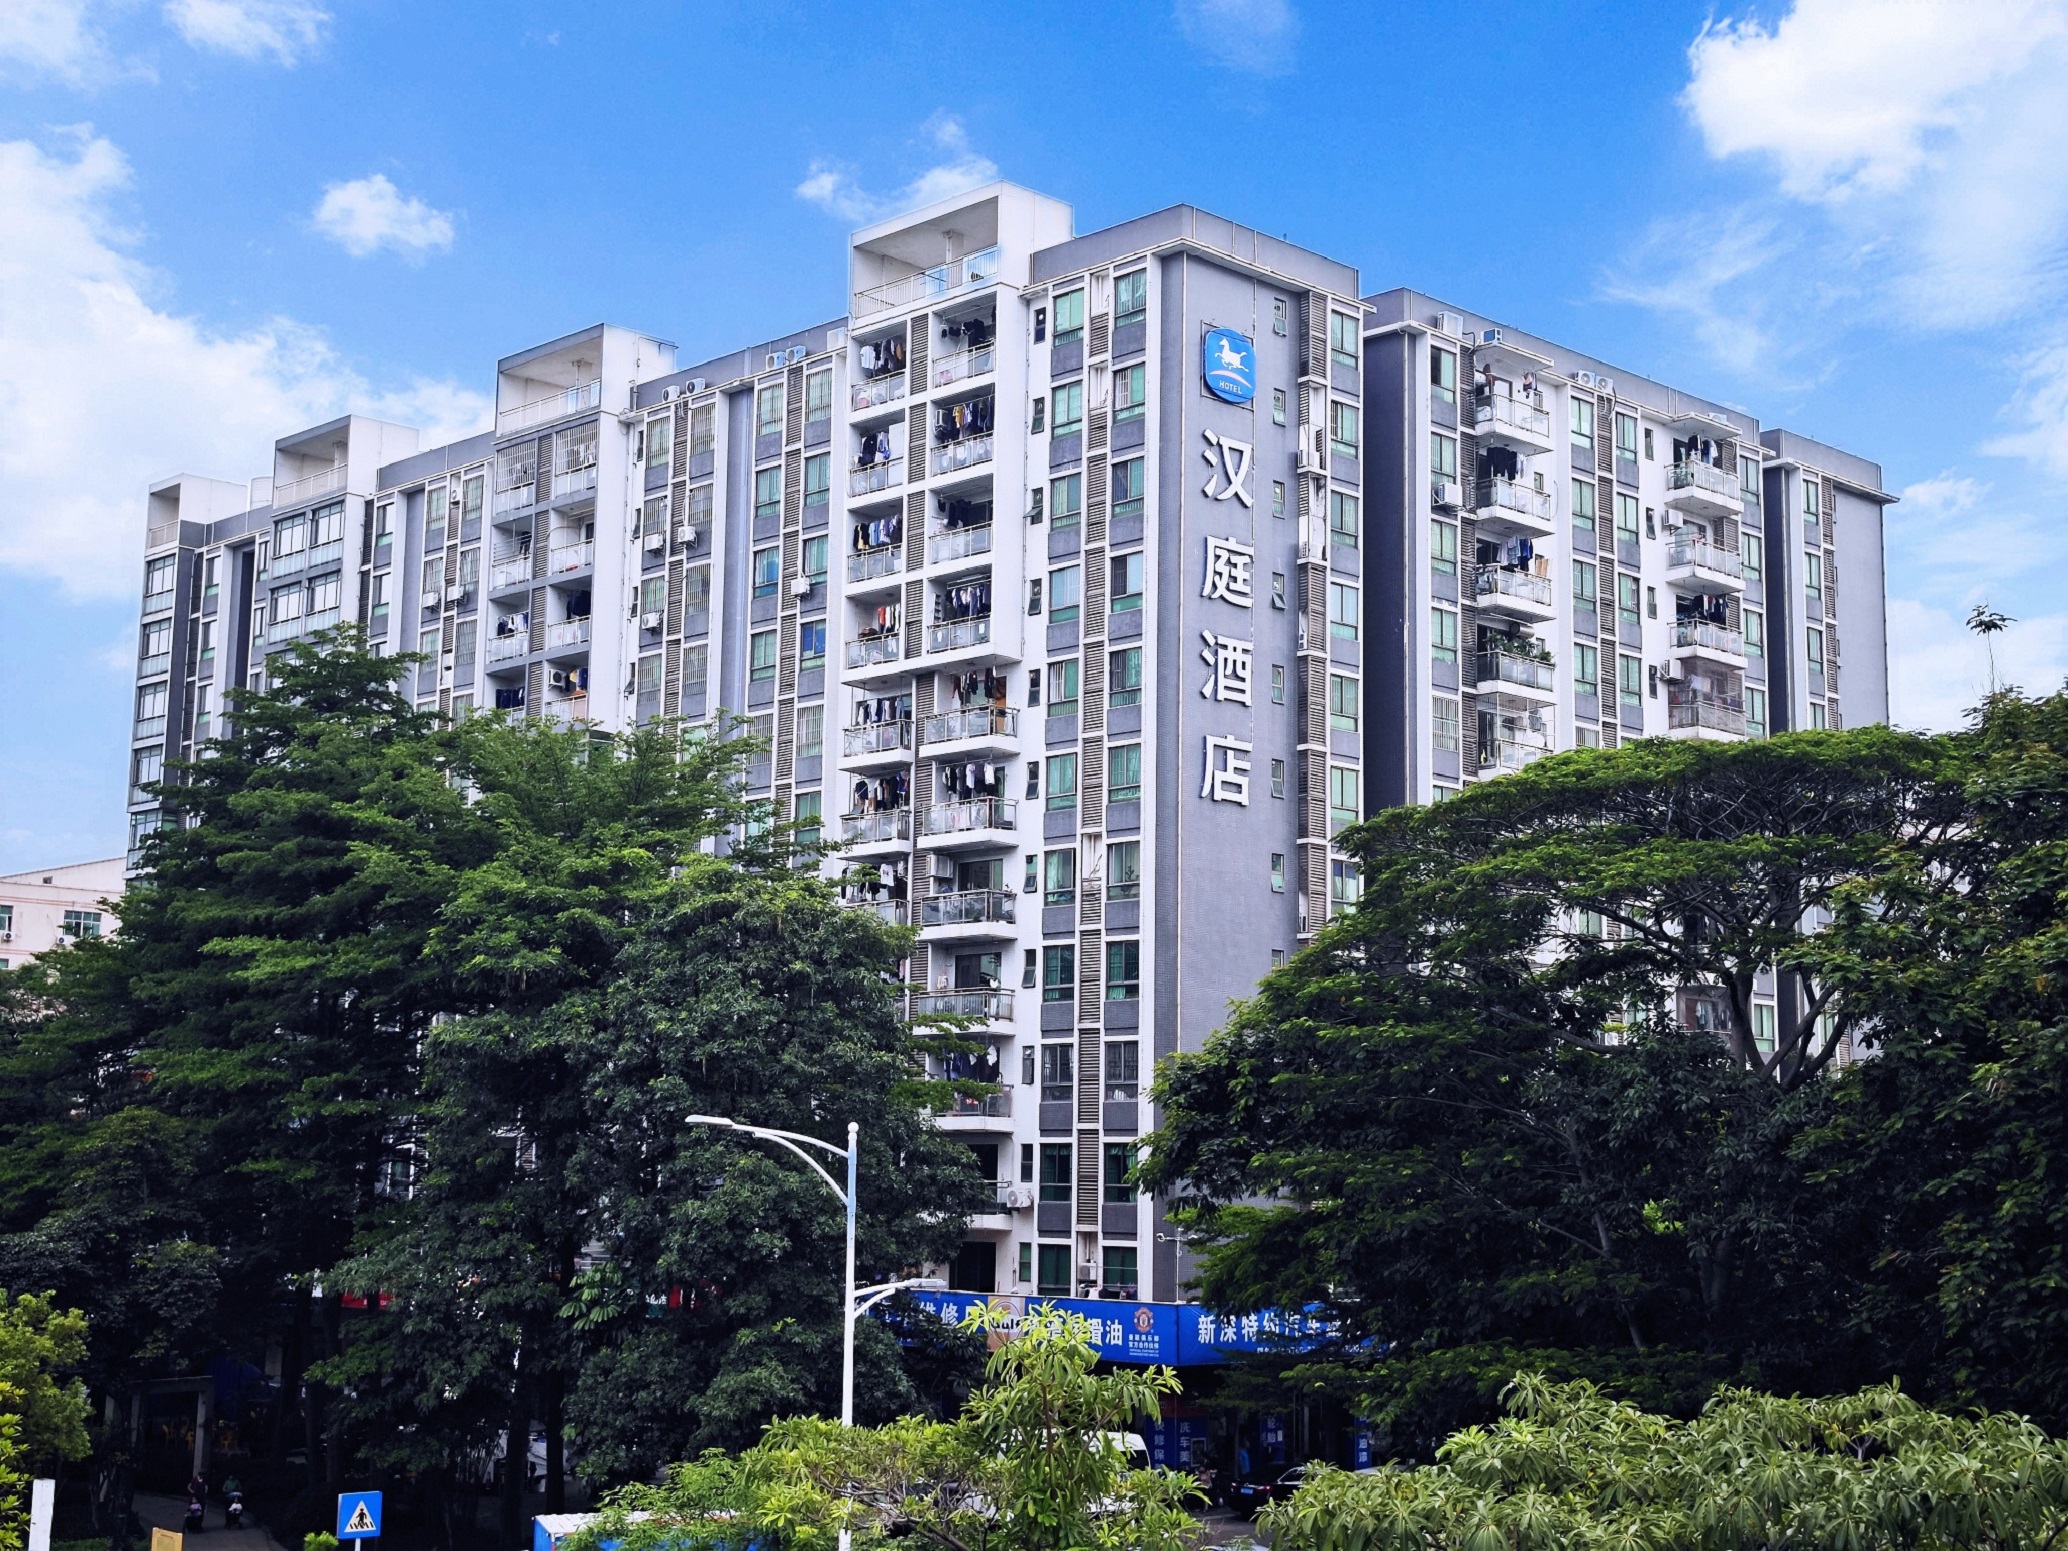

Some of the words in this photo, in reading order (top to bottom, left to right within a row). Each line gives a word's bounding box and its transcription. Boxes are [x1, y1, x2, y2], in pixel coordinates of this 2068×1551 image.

[1219, 380, 1243, 394] HOTEL
[1201, 428, 1254, 806] 汉庭酒店
[1180, 1422, 1191, 1470] 洗车美
